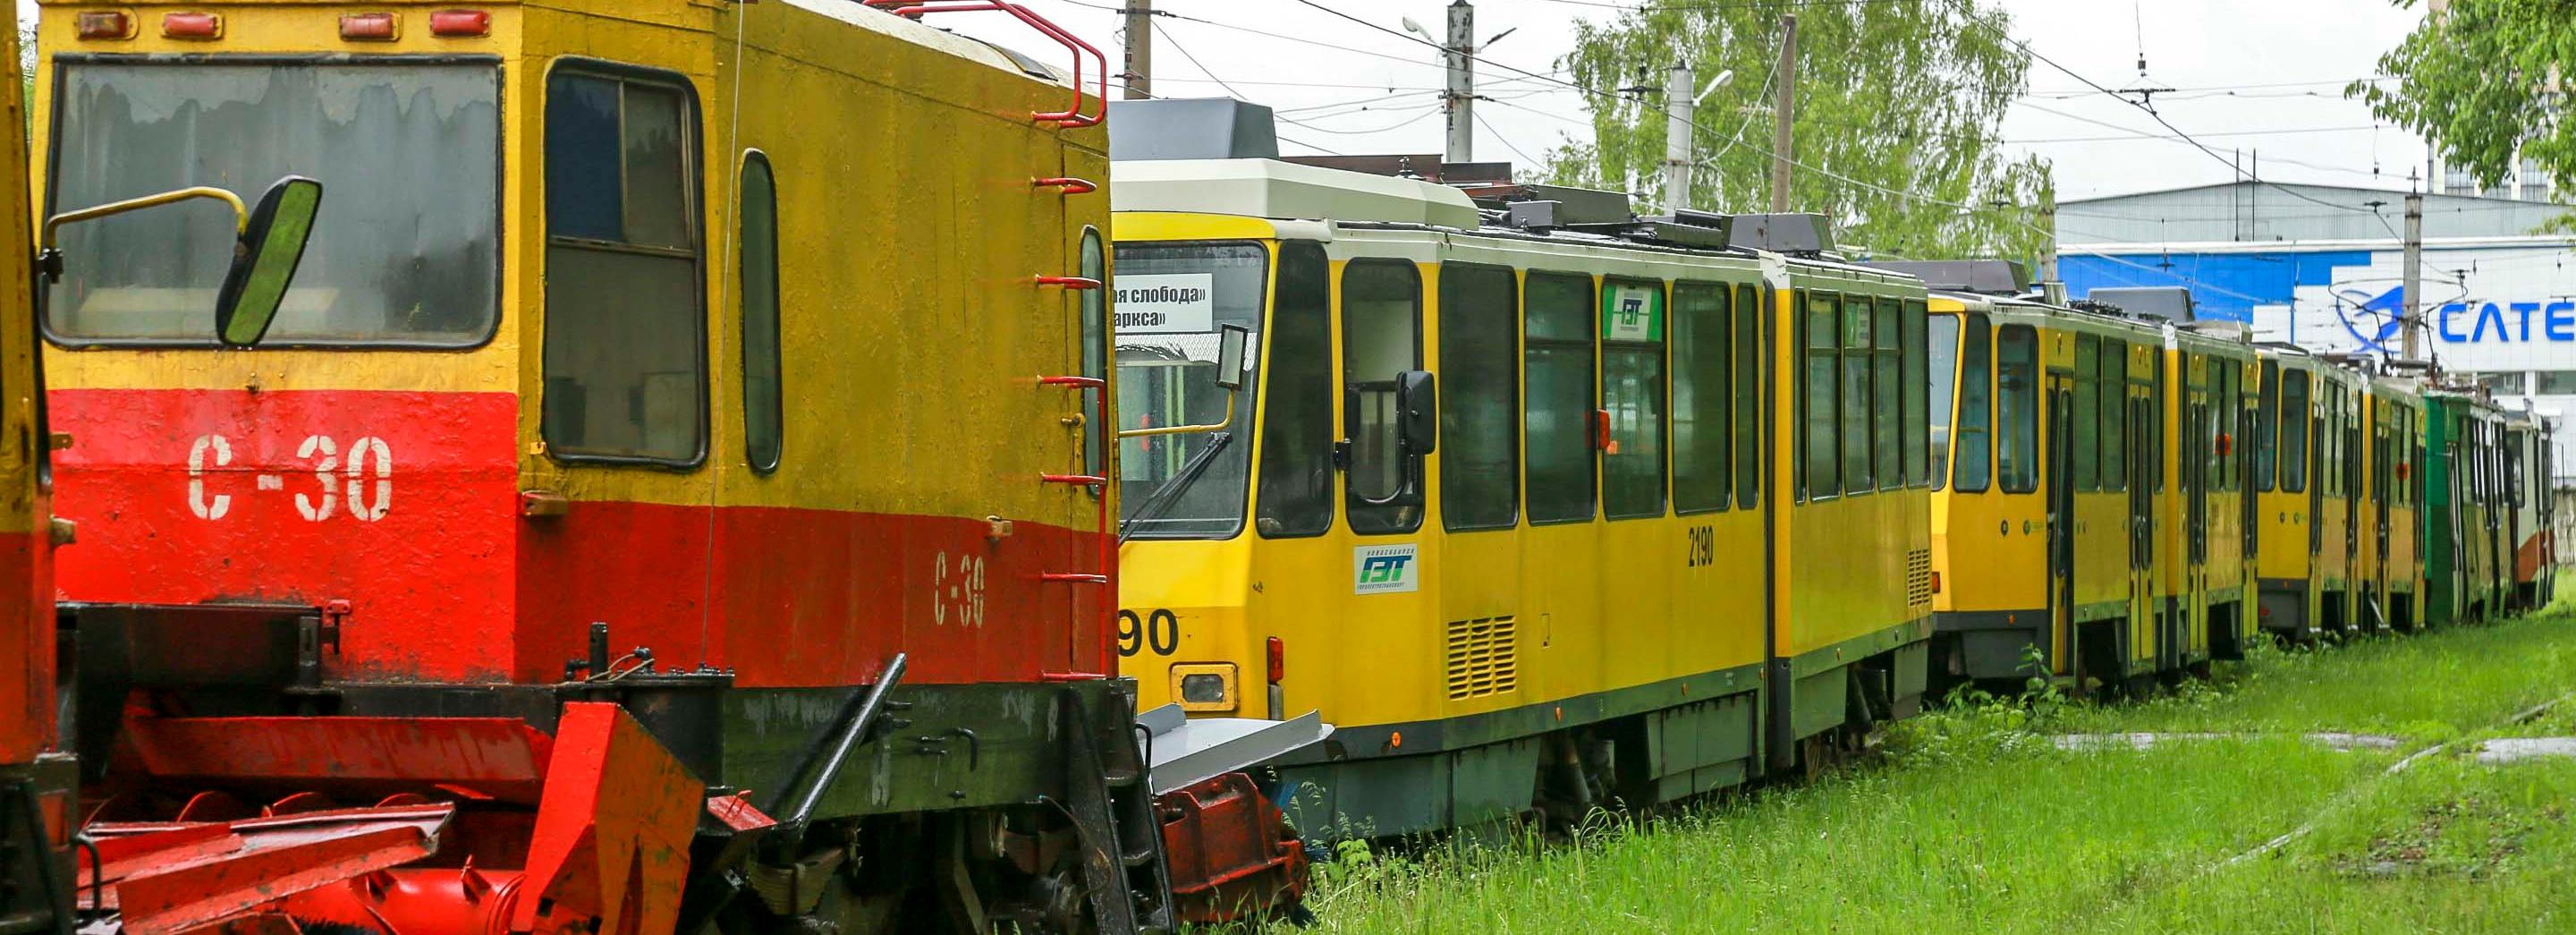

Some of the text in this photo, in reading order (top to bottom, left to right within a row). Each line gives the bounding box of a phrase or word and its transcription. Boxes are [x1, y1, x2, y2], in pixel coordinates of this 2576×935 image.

[1131, 286, 1206, 304] слобода»
[1689, 525, 1713, 567] 2190
[1118, 608, 1179, 657] 90
